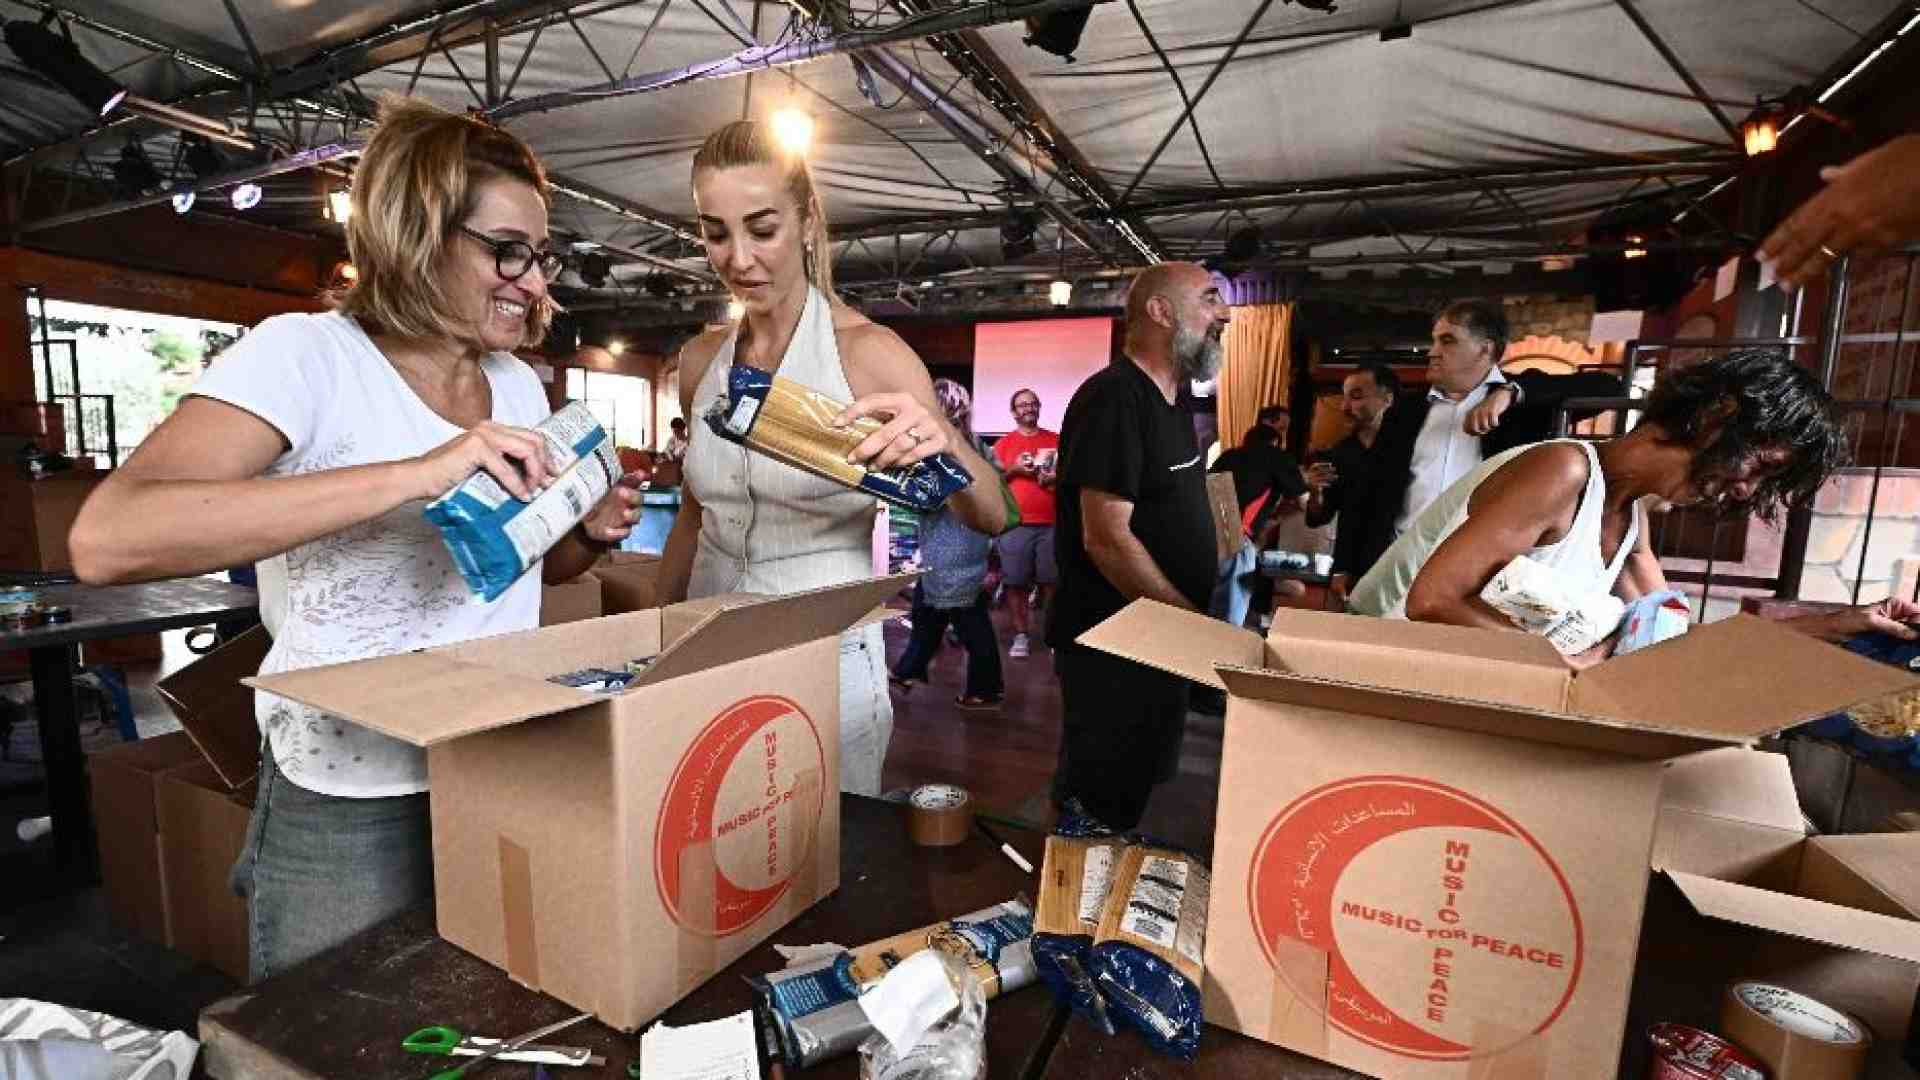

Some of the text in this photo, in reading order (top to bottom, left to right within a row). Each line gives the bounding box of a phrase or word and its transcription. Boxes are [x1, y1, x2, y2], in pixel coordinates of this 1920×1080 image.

[717, 807, 760, 837] MUSIC
[1436, 839, 1471, 924] MUSIC
[1341, 902, 1564, 969] MUSIC FOR PEACE
[1426, 947, 1453, 1023] PEACE
